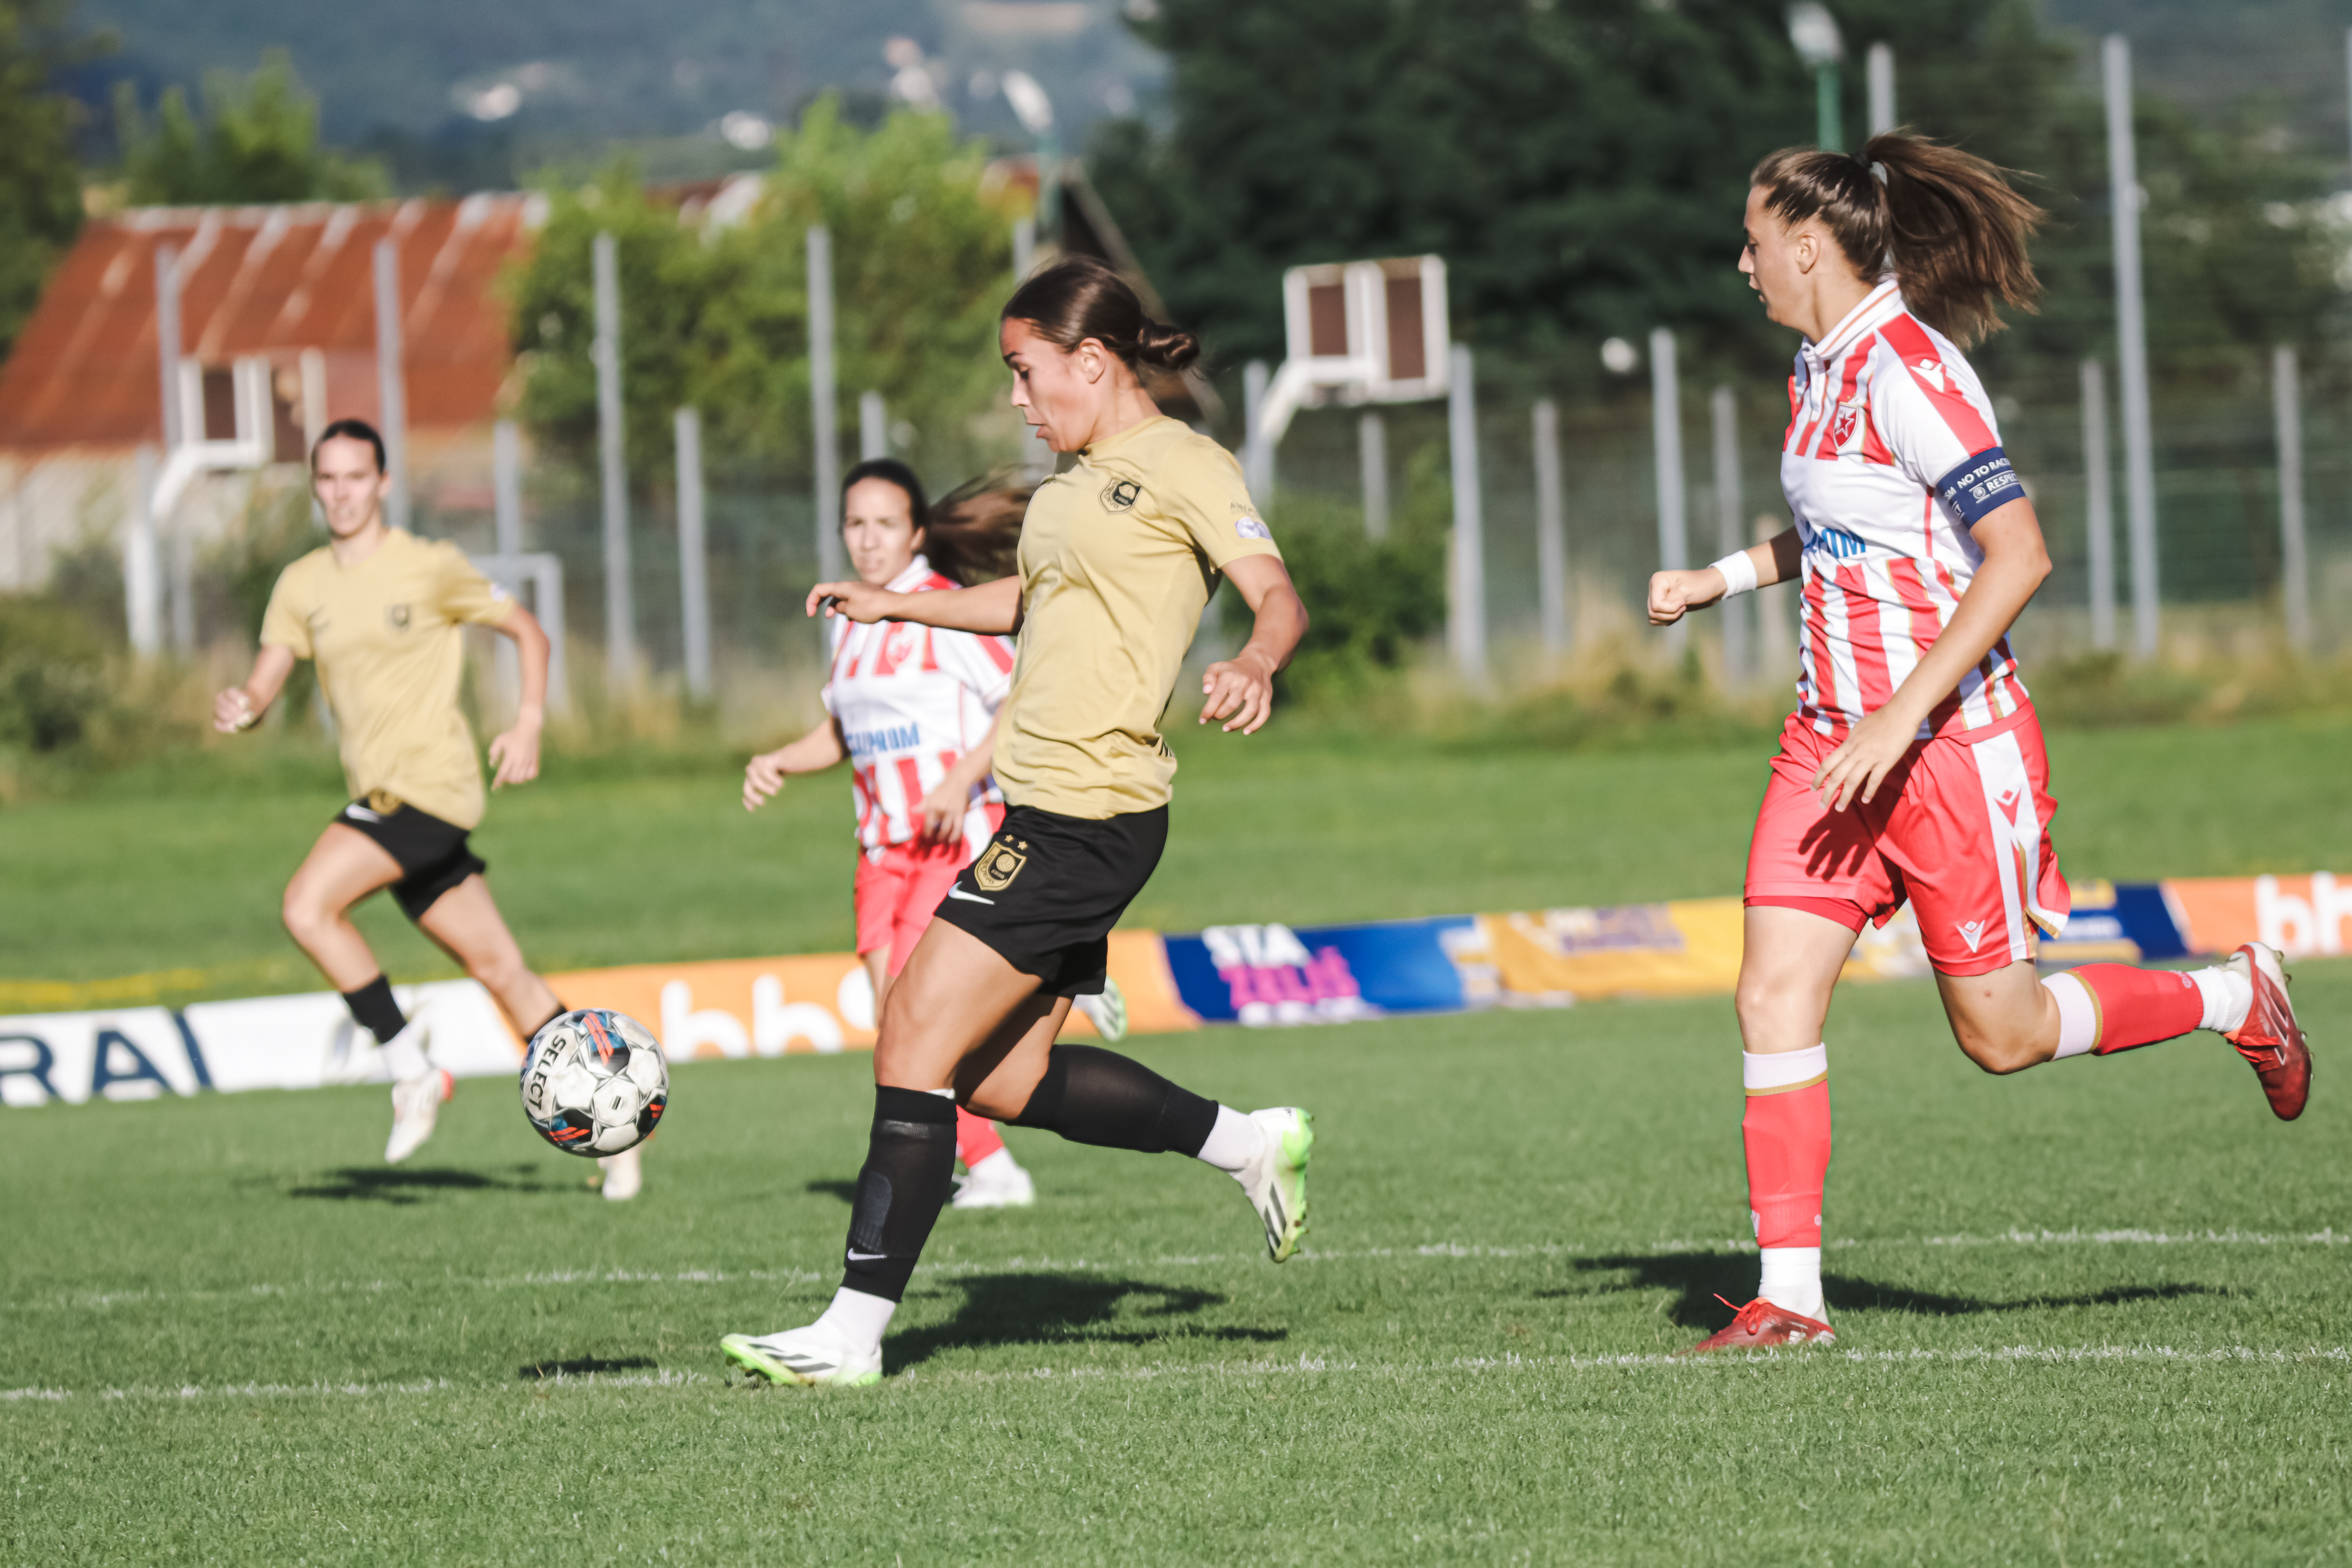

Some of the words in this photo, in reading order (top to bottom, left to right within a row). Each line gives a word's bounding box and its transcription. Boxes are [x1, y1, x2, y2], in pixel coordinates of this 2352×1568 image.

[1957, 474, 1975, 489] NO
[1973, 466, 1990, 478] TO
[1986, 473, 2018, 492] RESPEC
[529, 1035, 566, 1110] SELECT
